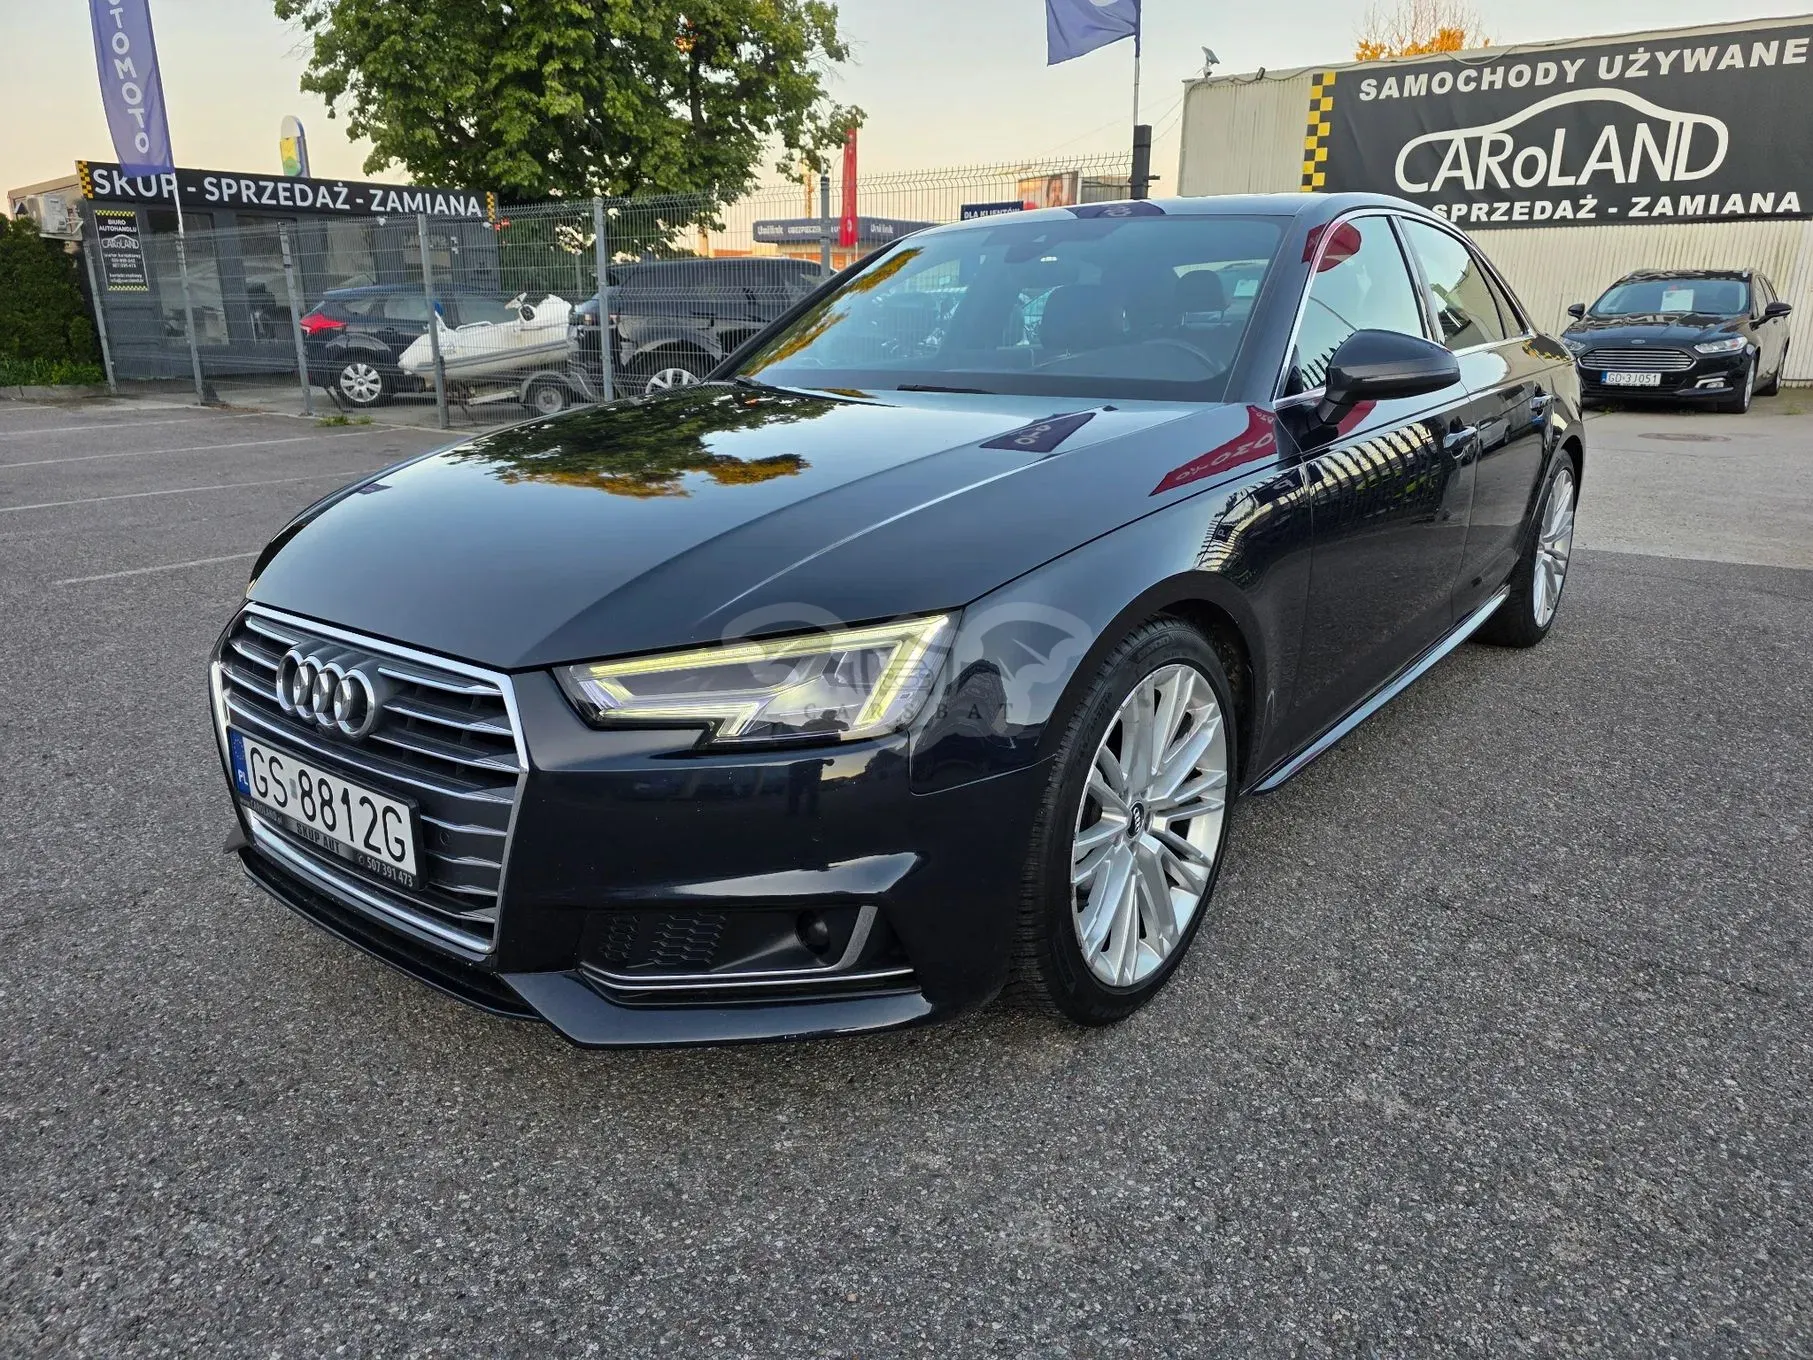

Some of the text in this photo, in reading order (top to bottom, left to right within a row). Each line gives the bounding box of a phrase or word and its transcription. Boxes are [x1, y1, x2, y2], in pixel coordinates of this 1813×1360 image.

[1359, 37, 1810, 101] SAMOCHODY UŻYWANE
[93, 168, 178, 199] SKUP
[203, 176, 350, 210] SPRZEDAŻ
[369, 189, 482, 217] ZAMIANA
[1432, 194, 1598, 222] SPRZEDAŻ
[1628, 192, 1801, 217] ZAMIANA
[99, 225, 137, 233] AUTOHANDLU
[964, 211, 979, 219] DLA
[237, 769, 249, 786] PL
[250, 747, 407, 863] GS 8812G
[296, 822, 340, 854] SKUP AUT
[367, 856, 413, 887] 507 391 473
